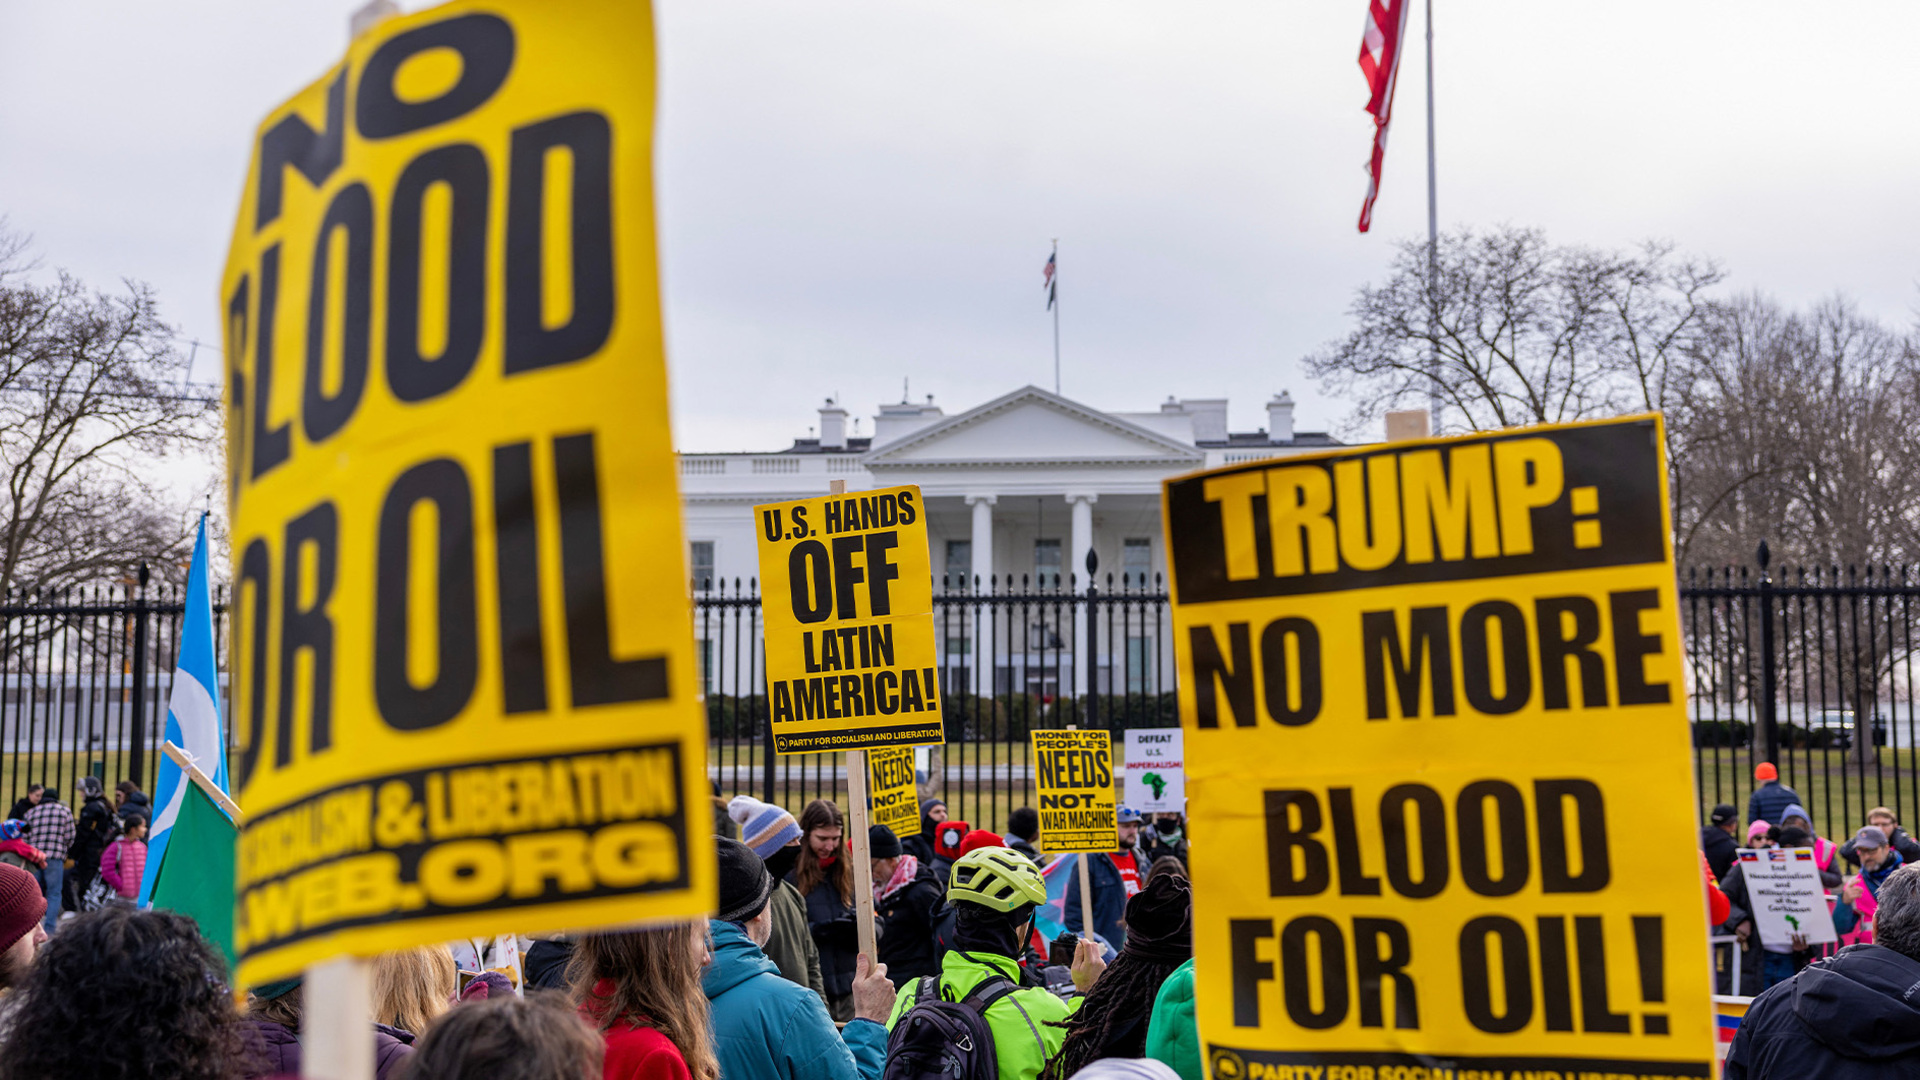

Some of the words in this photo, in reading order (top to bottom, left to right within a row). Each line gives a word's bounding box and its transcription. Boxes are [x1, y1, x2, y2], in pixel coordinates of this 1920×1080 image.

[255, 13, 516, 236] NO
[764, 506, 817, 542] U.S.
[825, 491, 916, 534] HANDS
[1203, 437, 1602, 582] TRUMP:
[789, 531, 899, 624] OFF
[232, 500, 341, 793] OR
[371, 431, 671, 733] OIL
[803, 623, 895, 673] LATIN
[1189, 616, 1323, 730] NO
[1361, 588, 1672, 721] MORE
[773, 667, 937, 723] AMERICA!
[788, 738, 814, 747] PARTY
[814, 737, 831, 745] FOR
[831, 734, 874, 744] SOCIALISM
[874, 732, 893, 741] AND
[893, 729, 942, 739] LIBERATION
[1036, 740, 1108, 749] PEOPLE'S
[1138, 735, 1172, 743] DEFEAT
[872, 755, 913, 792] NEEDS
[1038, 750, 1110, 789] NEEDS
[375, 781, 422, 849] &
[874, 791, 904, 808] NOT
[1040, 794, 1095, 809] NOT
[1041, 811, 1067, 830] WAR
[1069, 811, 1115, 829] MACHINE
[1262, 777, 1612, 899] BLOOD
[1229, 914, 1420, 1030] FOR
[1459, 913, 1671, 1036] OIL!
[1250, 1062, 1323, 1080] PARTY
[1327, 1065, 1375, 1080] FOR
